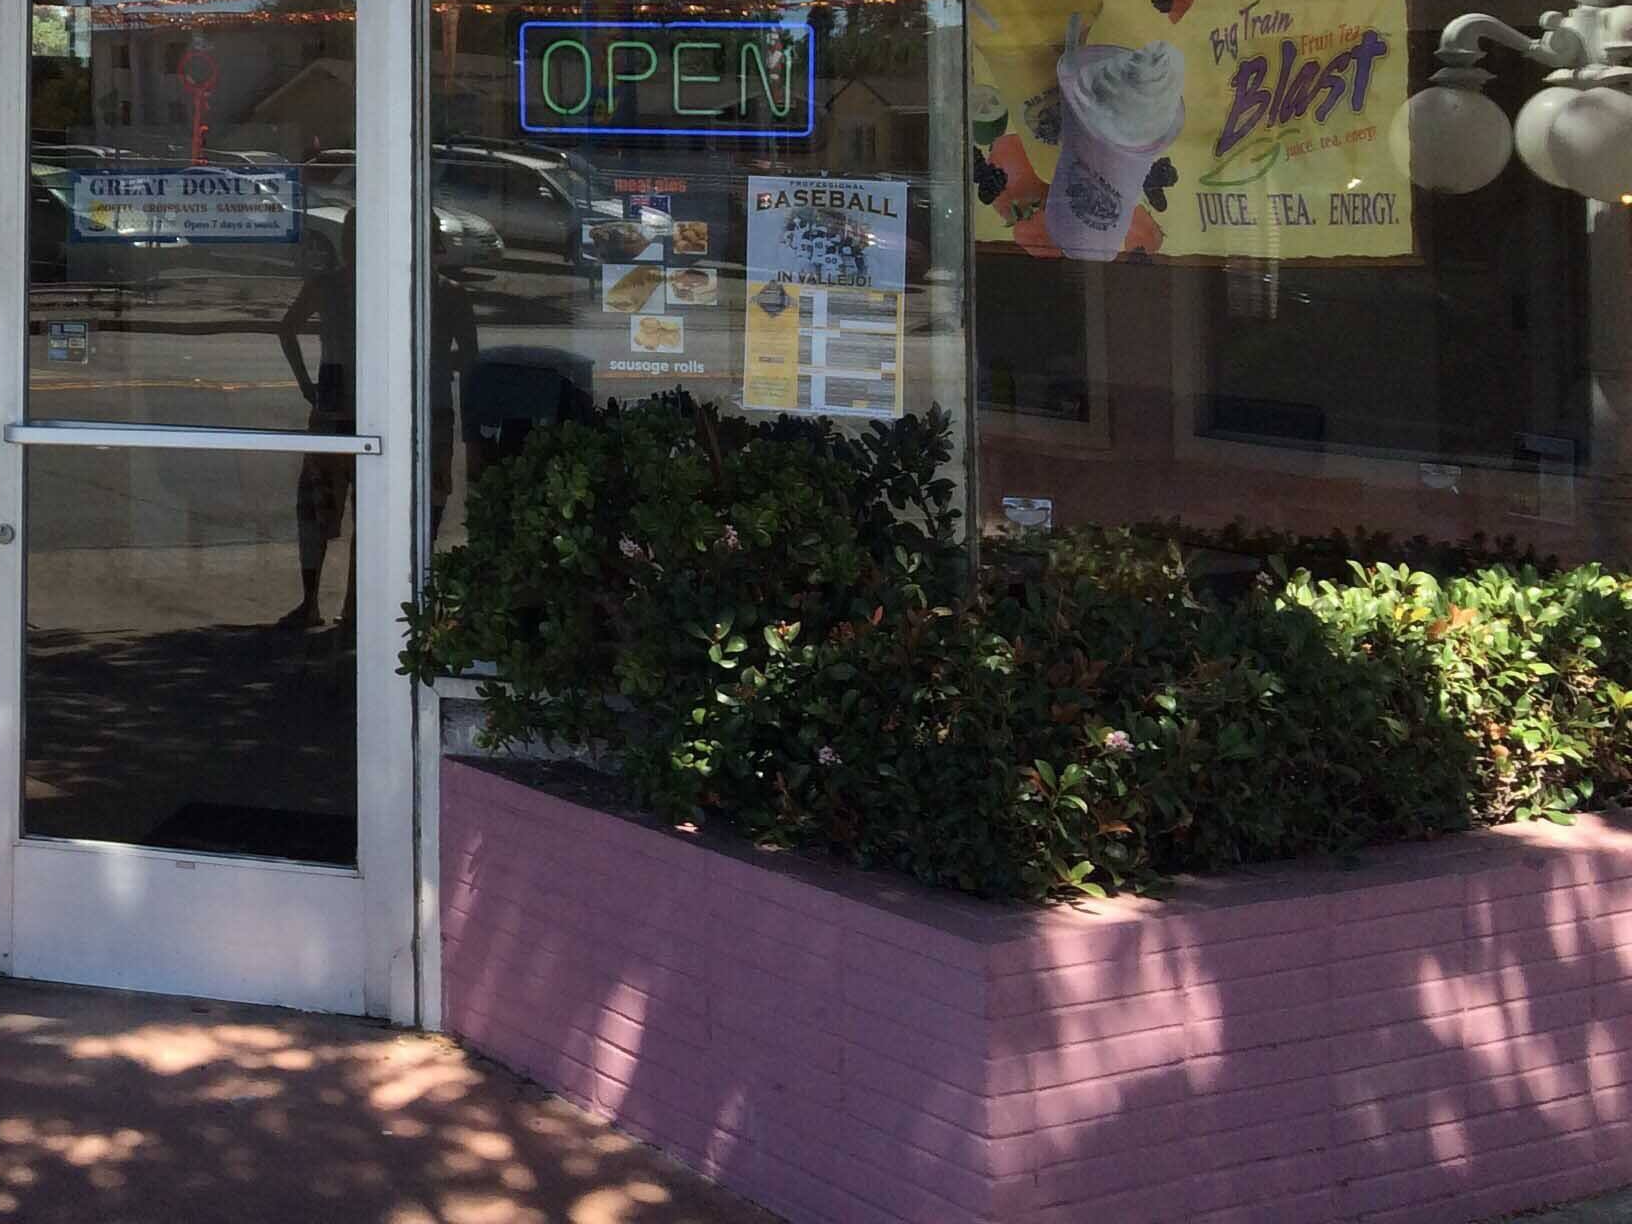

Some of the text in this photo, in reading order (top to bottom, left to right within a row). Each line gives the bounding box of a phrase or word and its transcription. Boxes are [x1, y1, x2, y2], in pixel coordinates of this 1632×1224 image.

[1209, 0, 1295, 65] Big Train
[541, 38, 794, 117] OPEN
[1215, 29, 1388, 157] Blast
[88, 176, 281, 197] GREAT DONUTS
[755, 188, 898, 219] BASEBALL
[1196, 192, 1400, 232] JUICE. TEA. ENERGY.
[778, 271, 872, 288] IN VALLEJO!
[609, 359, 705, 375] sausage rolls
